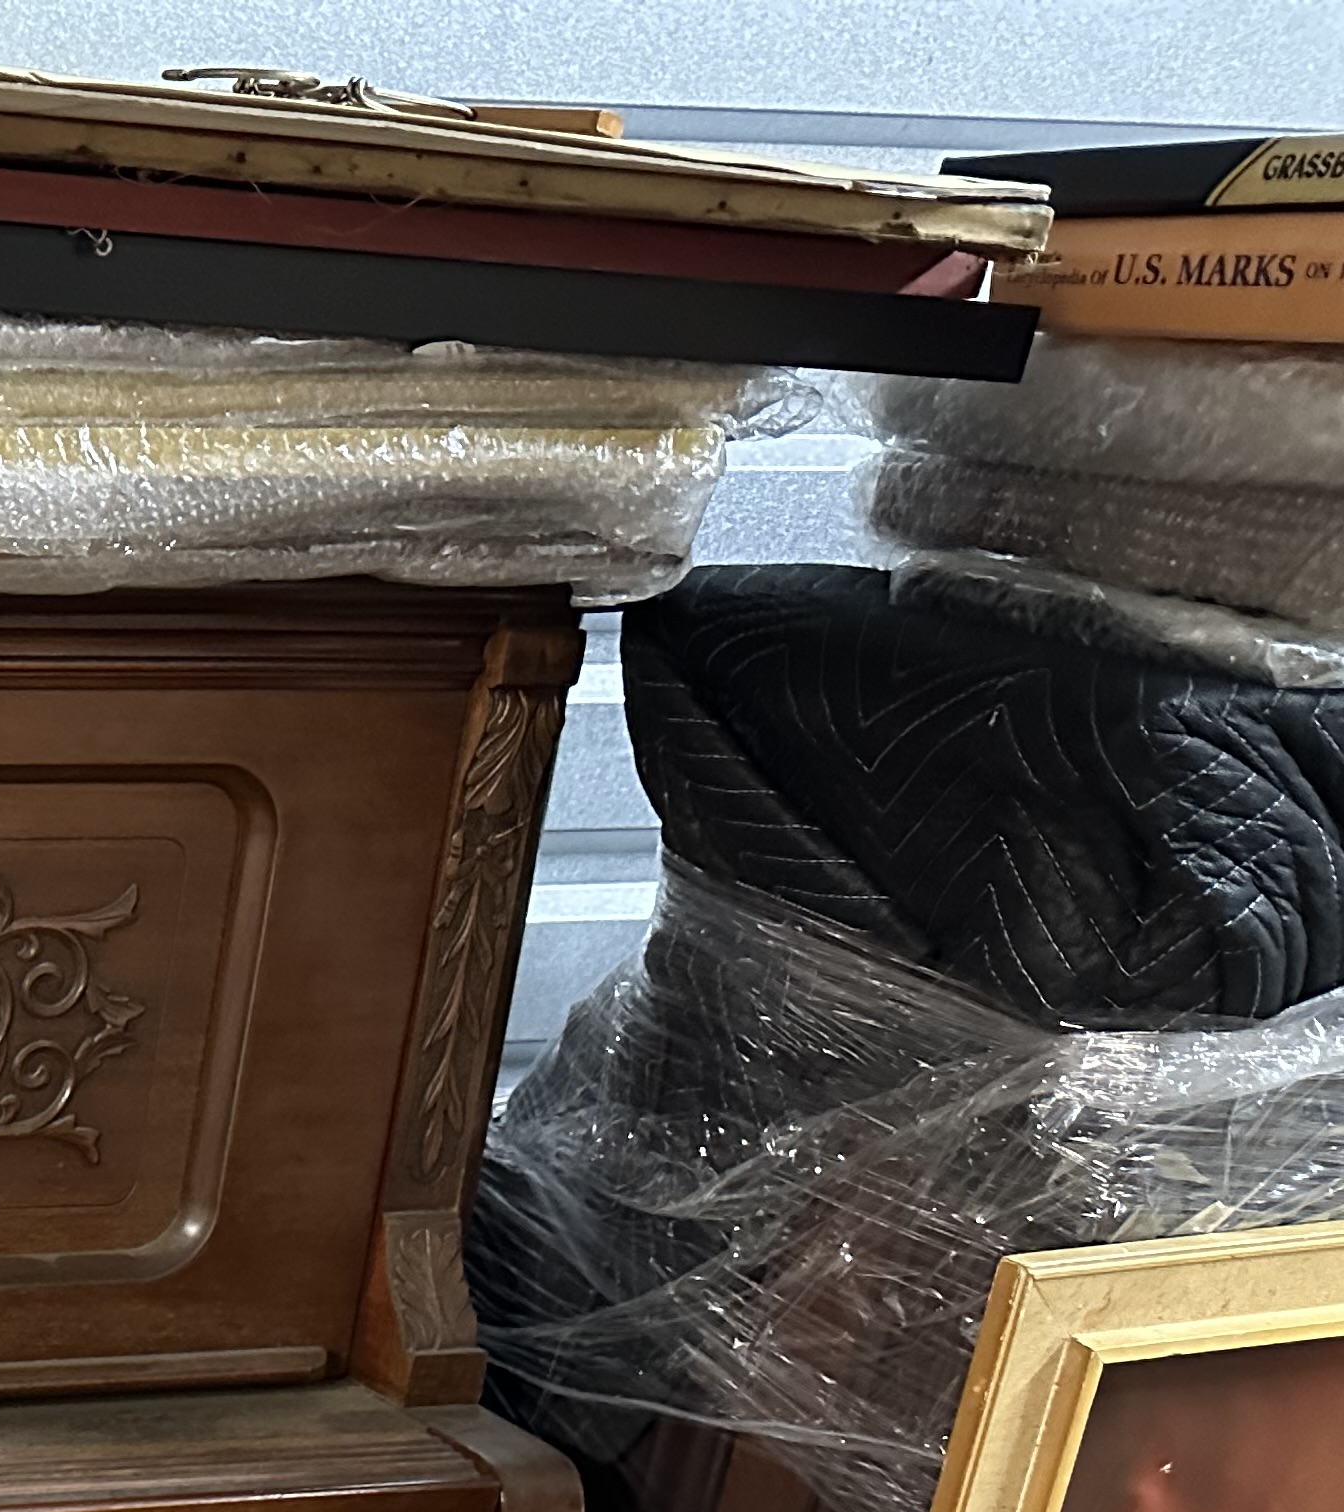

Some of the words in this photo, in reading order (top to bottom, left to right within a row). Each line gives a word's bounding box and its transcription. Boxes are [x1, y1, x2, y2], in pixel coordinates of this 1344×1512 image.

[1114, 254, 1166, 285] U.S.
[1177, 254, 1296, 287] MARKS
[1306, 262, 1333, 279] ON
